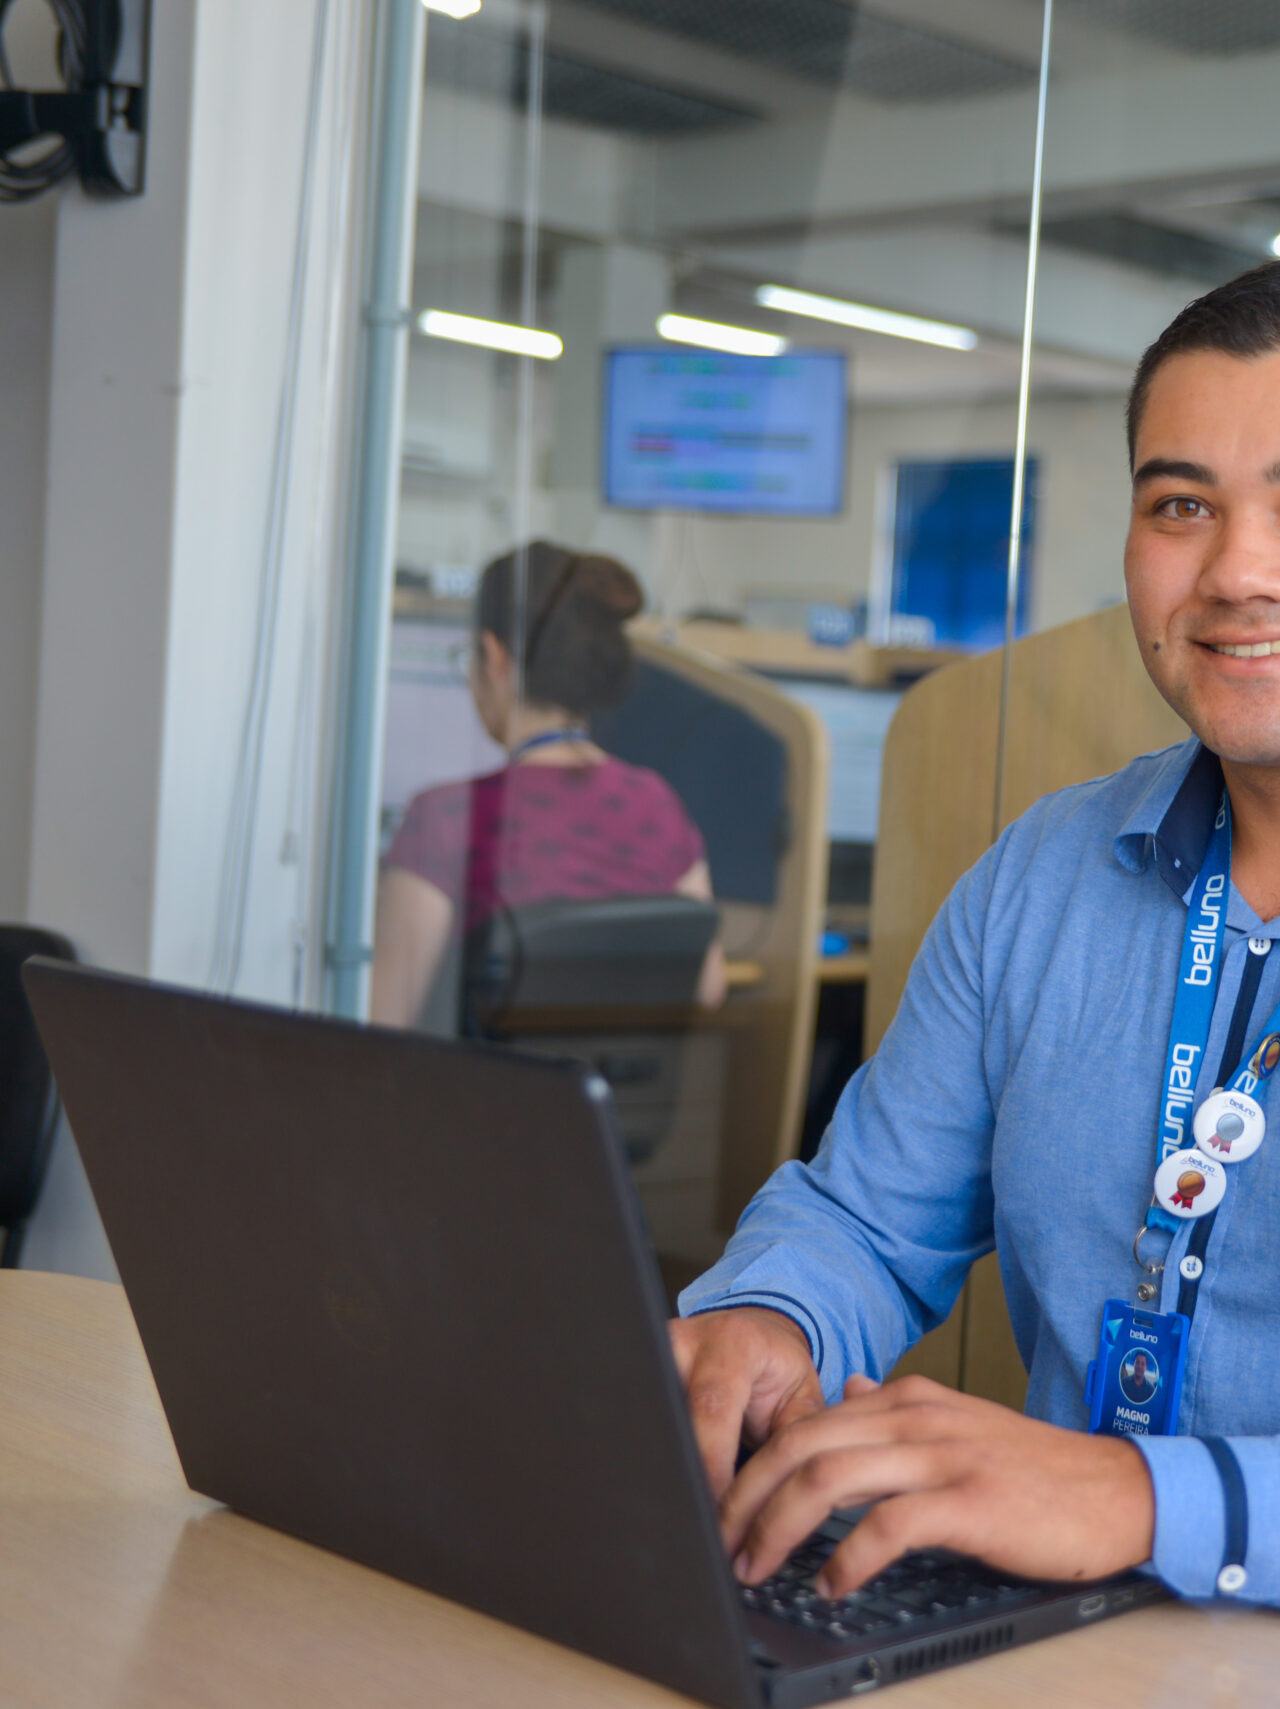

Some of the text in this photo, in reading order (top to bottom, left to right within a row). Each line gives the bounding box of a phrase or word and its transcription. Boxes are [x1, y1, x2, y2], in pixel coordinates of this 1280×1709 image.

[1184, 874, 1225, 986] belluno
[1129, 1329, 1158, 1344] belluno
[1116, 1405, 1150, 1425] MAGNO
[1112, 1418, 1149, 1436] PEREIRA
